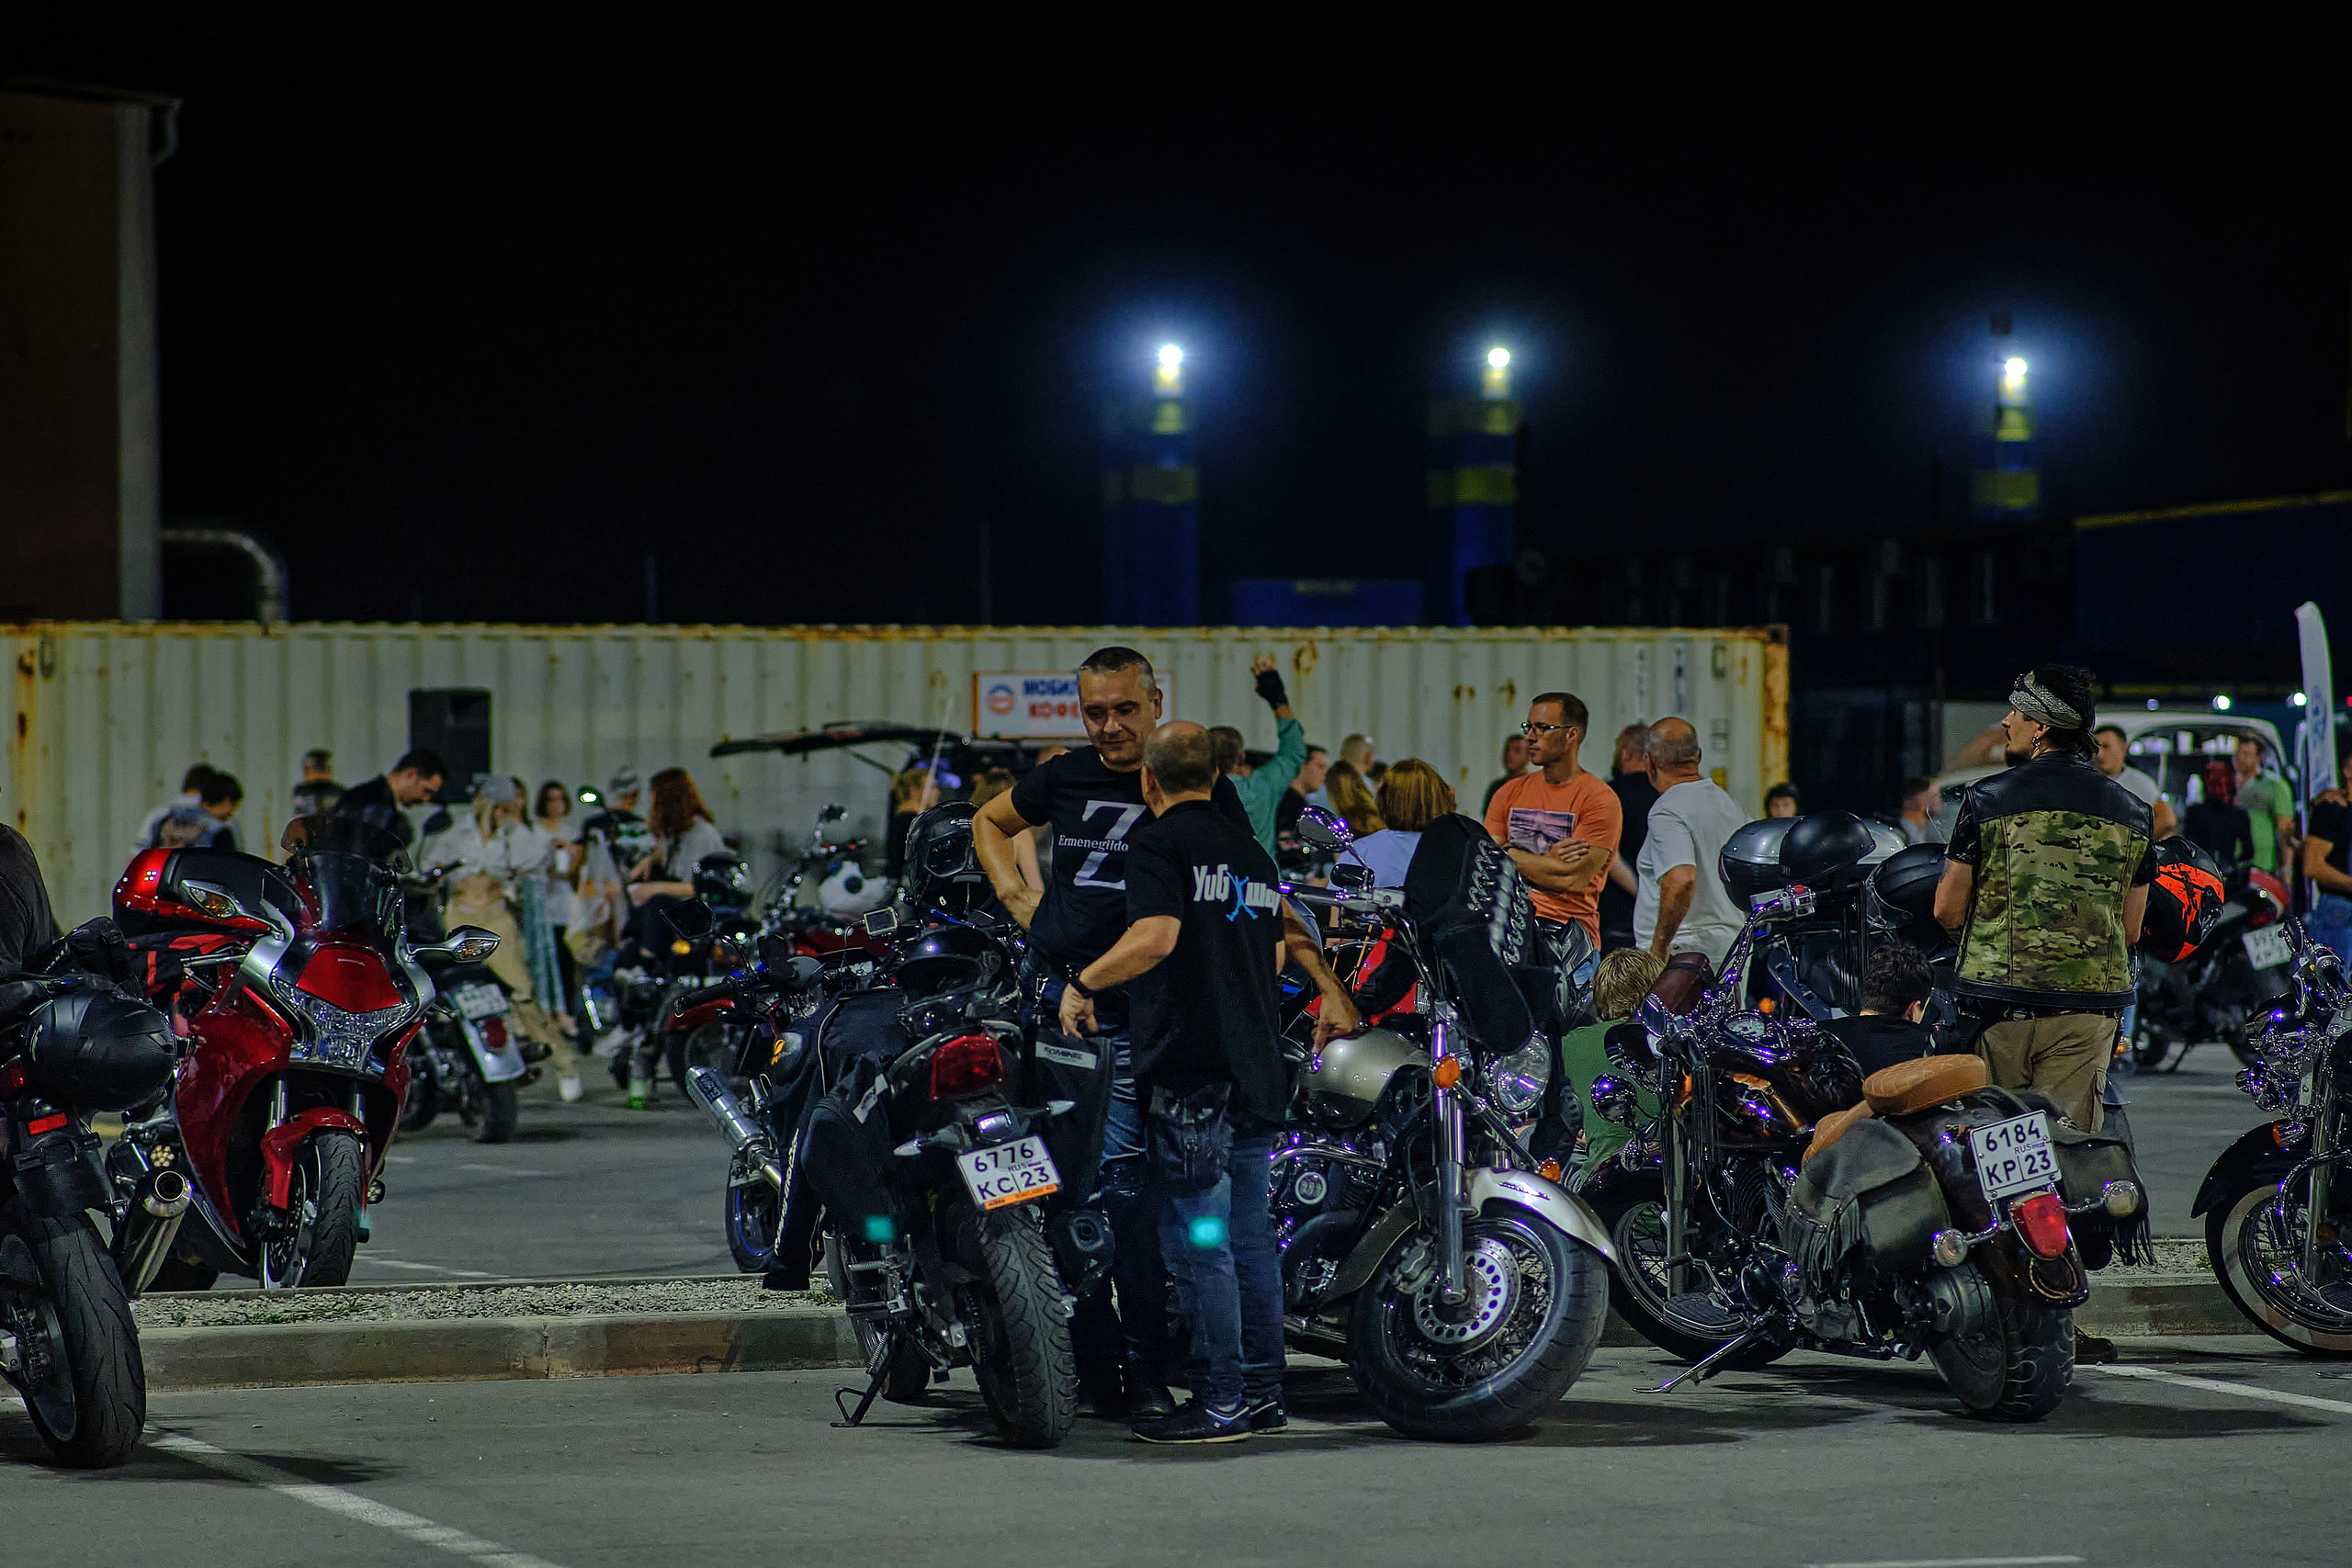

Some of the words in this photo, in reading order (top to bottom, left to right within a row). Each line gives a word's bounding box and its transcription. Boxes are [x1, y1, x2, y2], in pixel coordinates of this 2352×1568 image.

[1058, 834, 1129, 852] Ermenegildo
[1073, 800, 1147, 891] Z
[1985, 1119, 2041, 1152] 6184
[975, 1143, 1034, 1172] 6776
[2014, 1143, 2032, 1155] RUS
[1007, 1162, 1027, 1172] RUS
[2024, 1149, 2051, 1175] 23
[1020, 1167, 1050, 1188] 23
